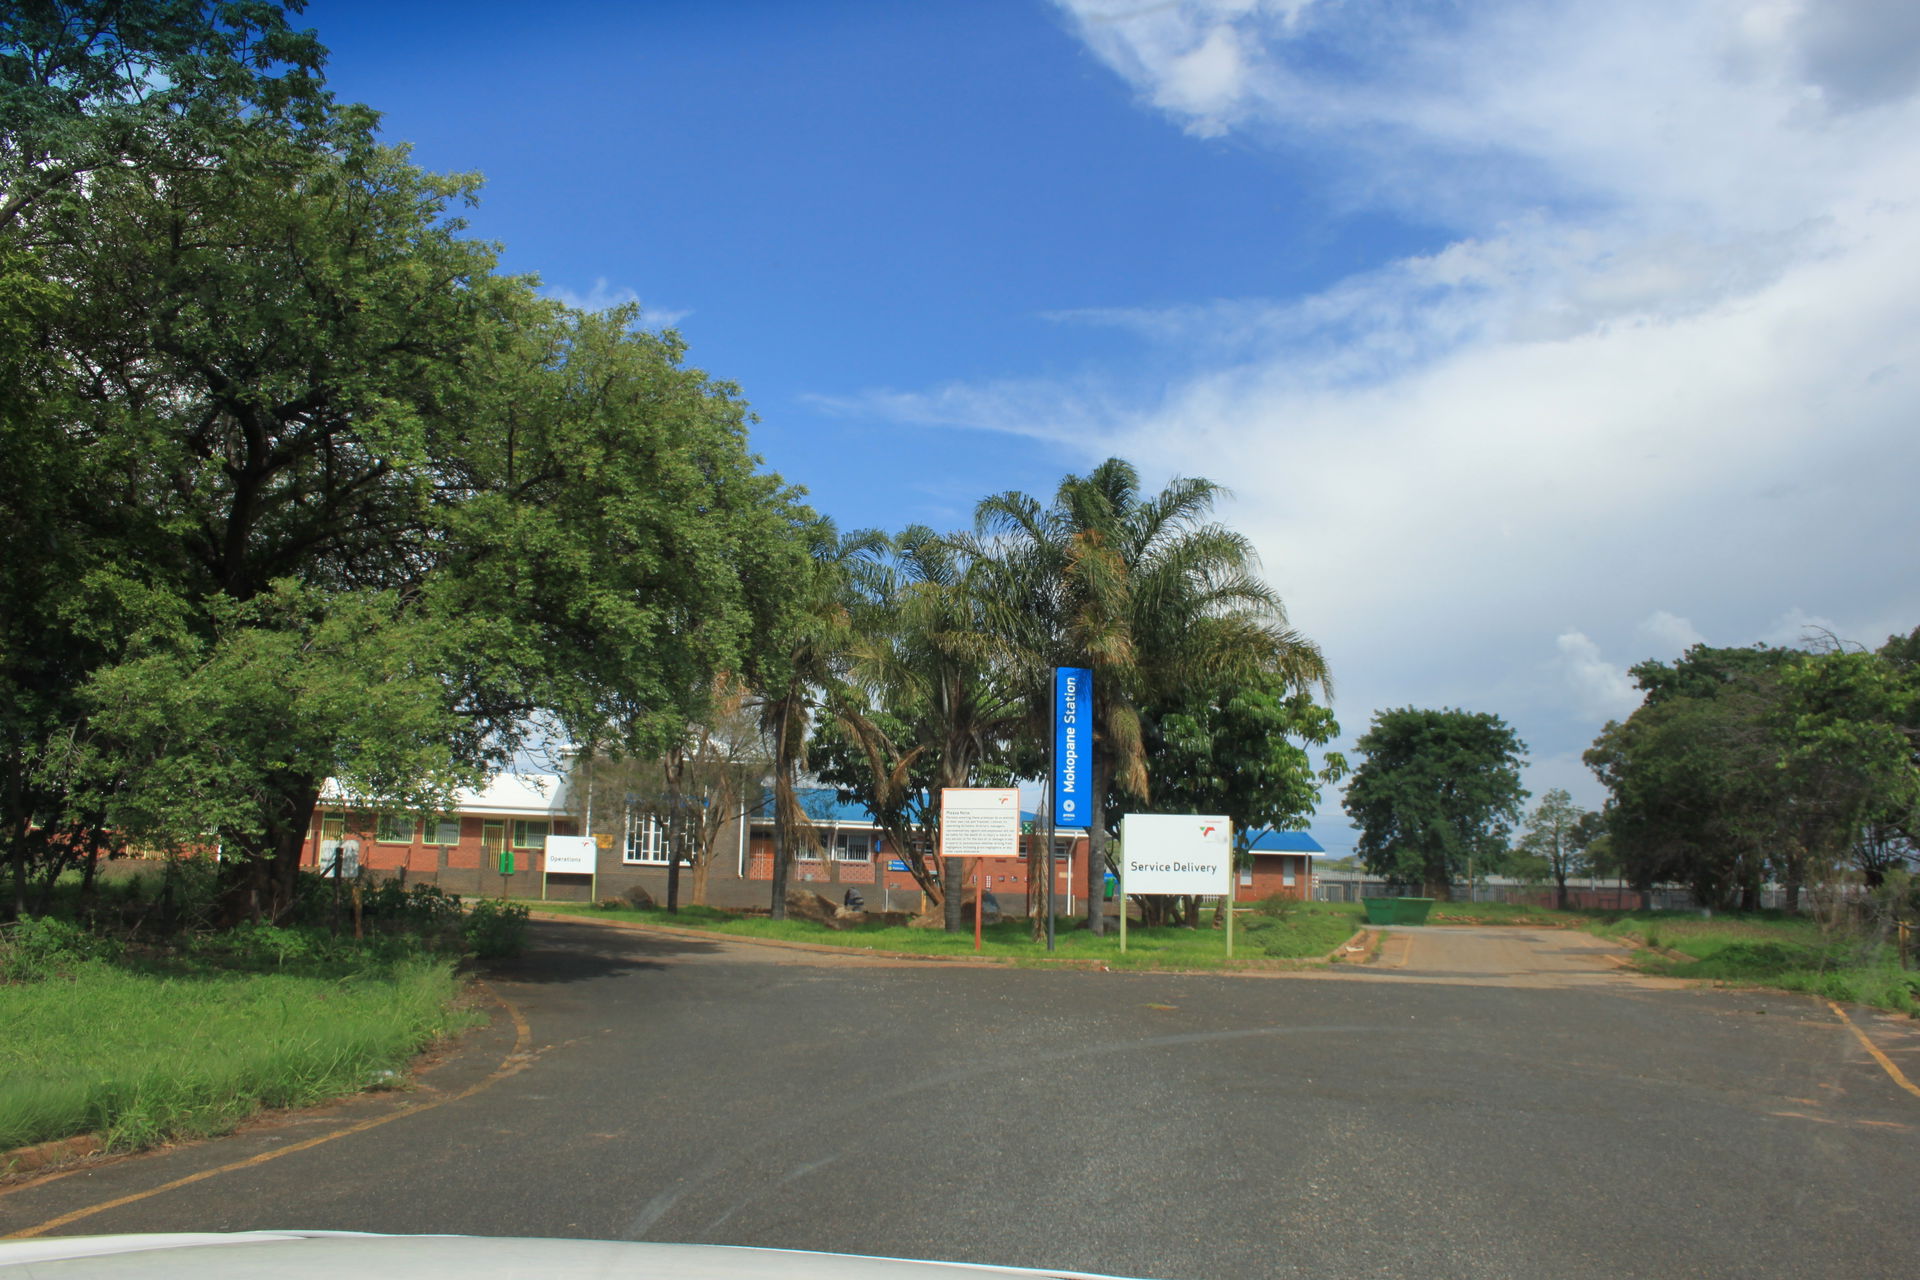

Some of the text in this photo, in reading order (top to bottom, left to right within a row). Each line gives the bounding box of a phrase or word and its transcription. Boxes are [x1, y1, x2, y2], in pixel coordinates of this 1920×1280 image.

[1063, 677, 1078, 793] Mokopane Station
[550, 855, 581, 863] Operations
[1130, 861, 1217, 875] Service Delivery
